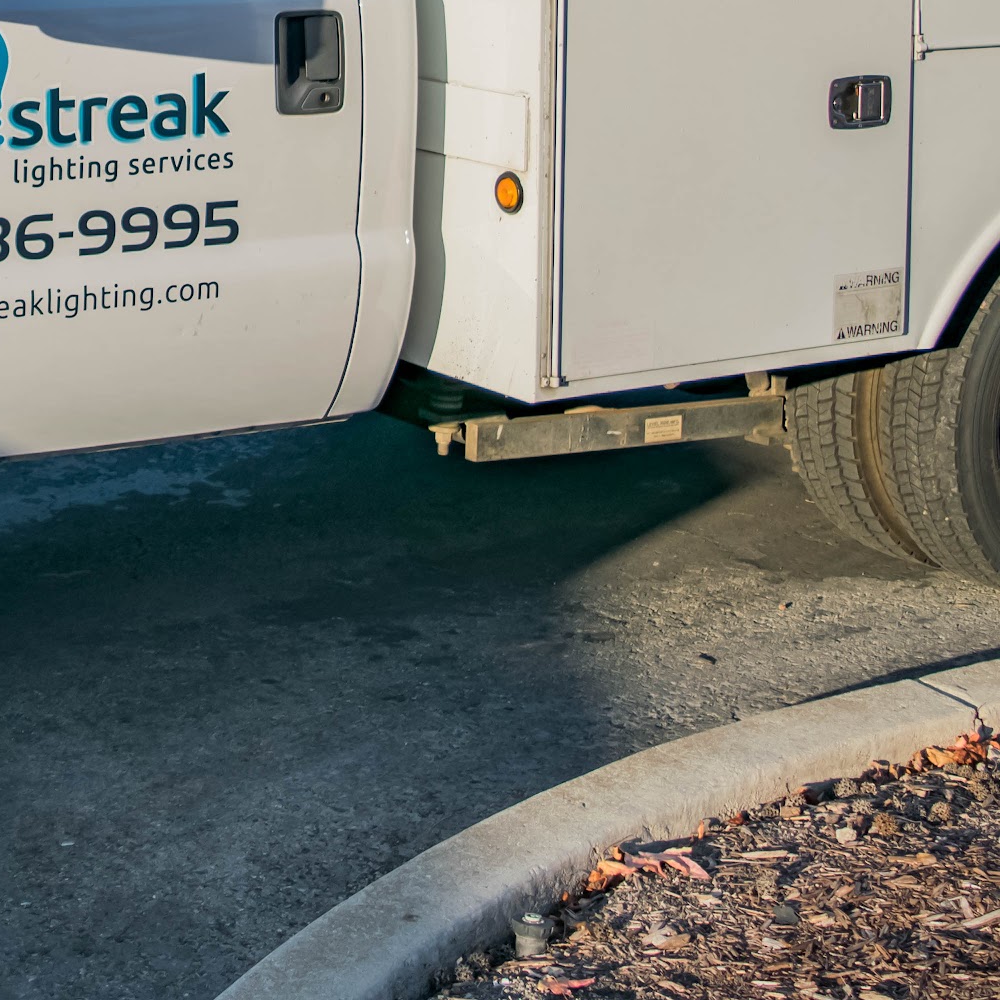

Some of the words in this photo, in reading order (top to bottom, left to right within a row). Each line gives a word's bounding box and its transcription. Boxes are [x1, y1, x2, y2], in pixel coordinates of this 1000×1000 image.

[8, 72, 231, 149] streak
[13, 157, 118, 188] lighting
[128, 150, 235, 176] services
[848, 272, 900, 288] RNING
[846, 321, 898, 338] WARNING
